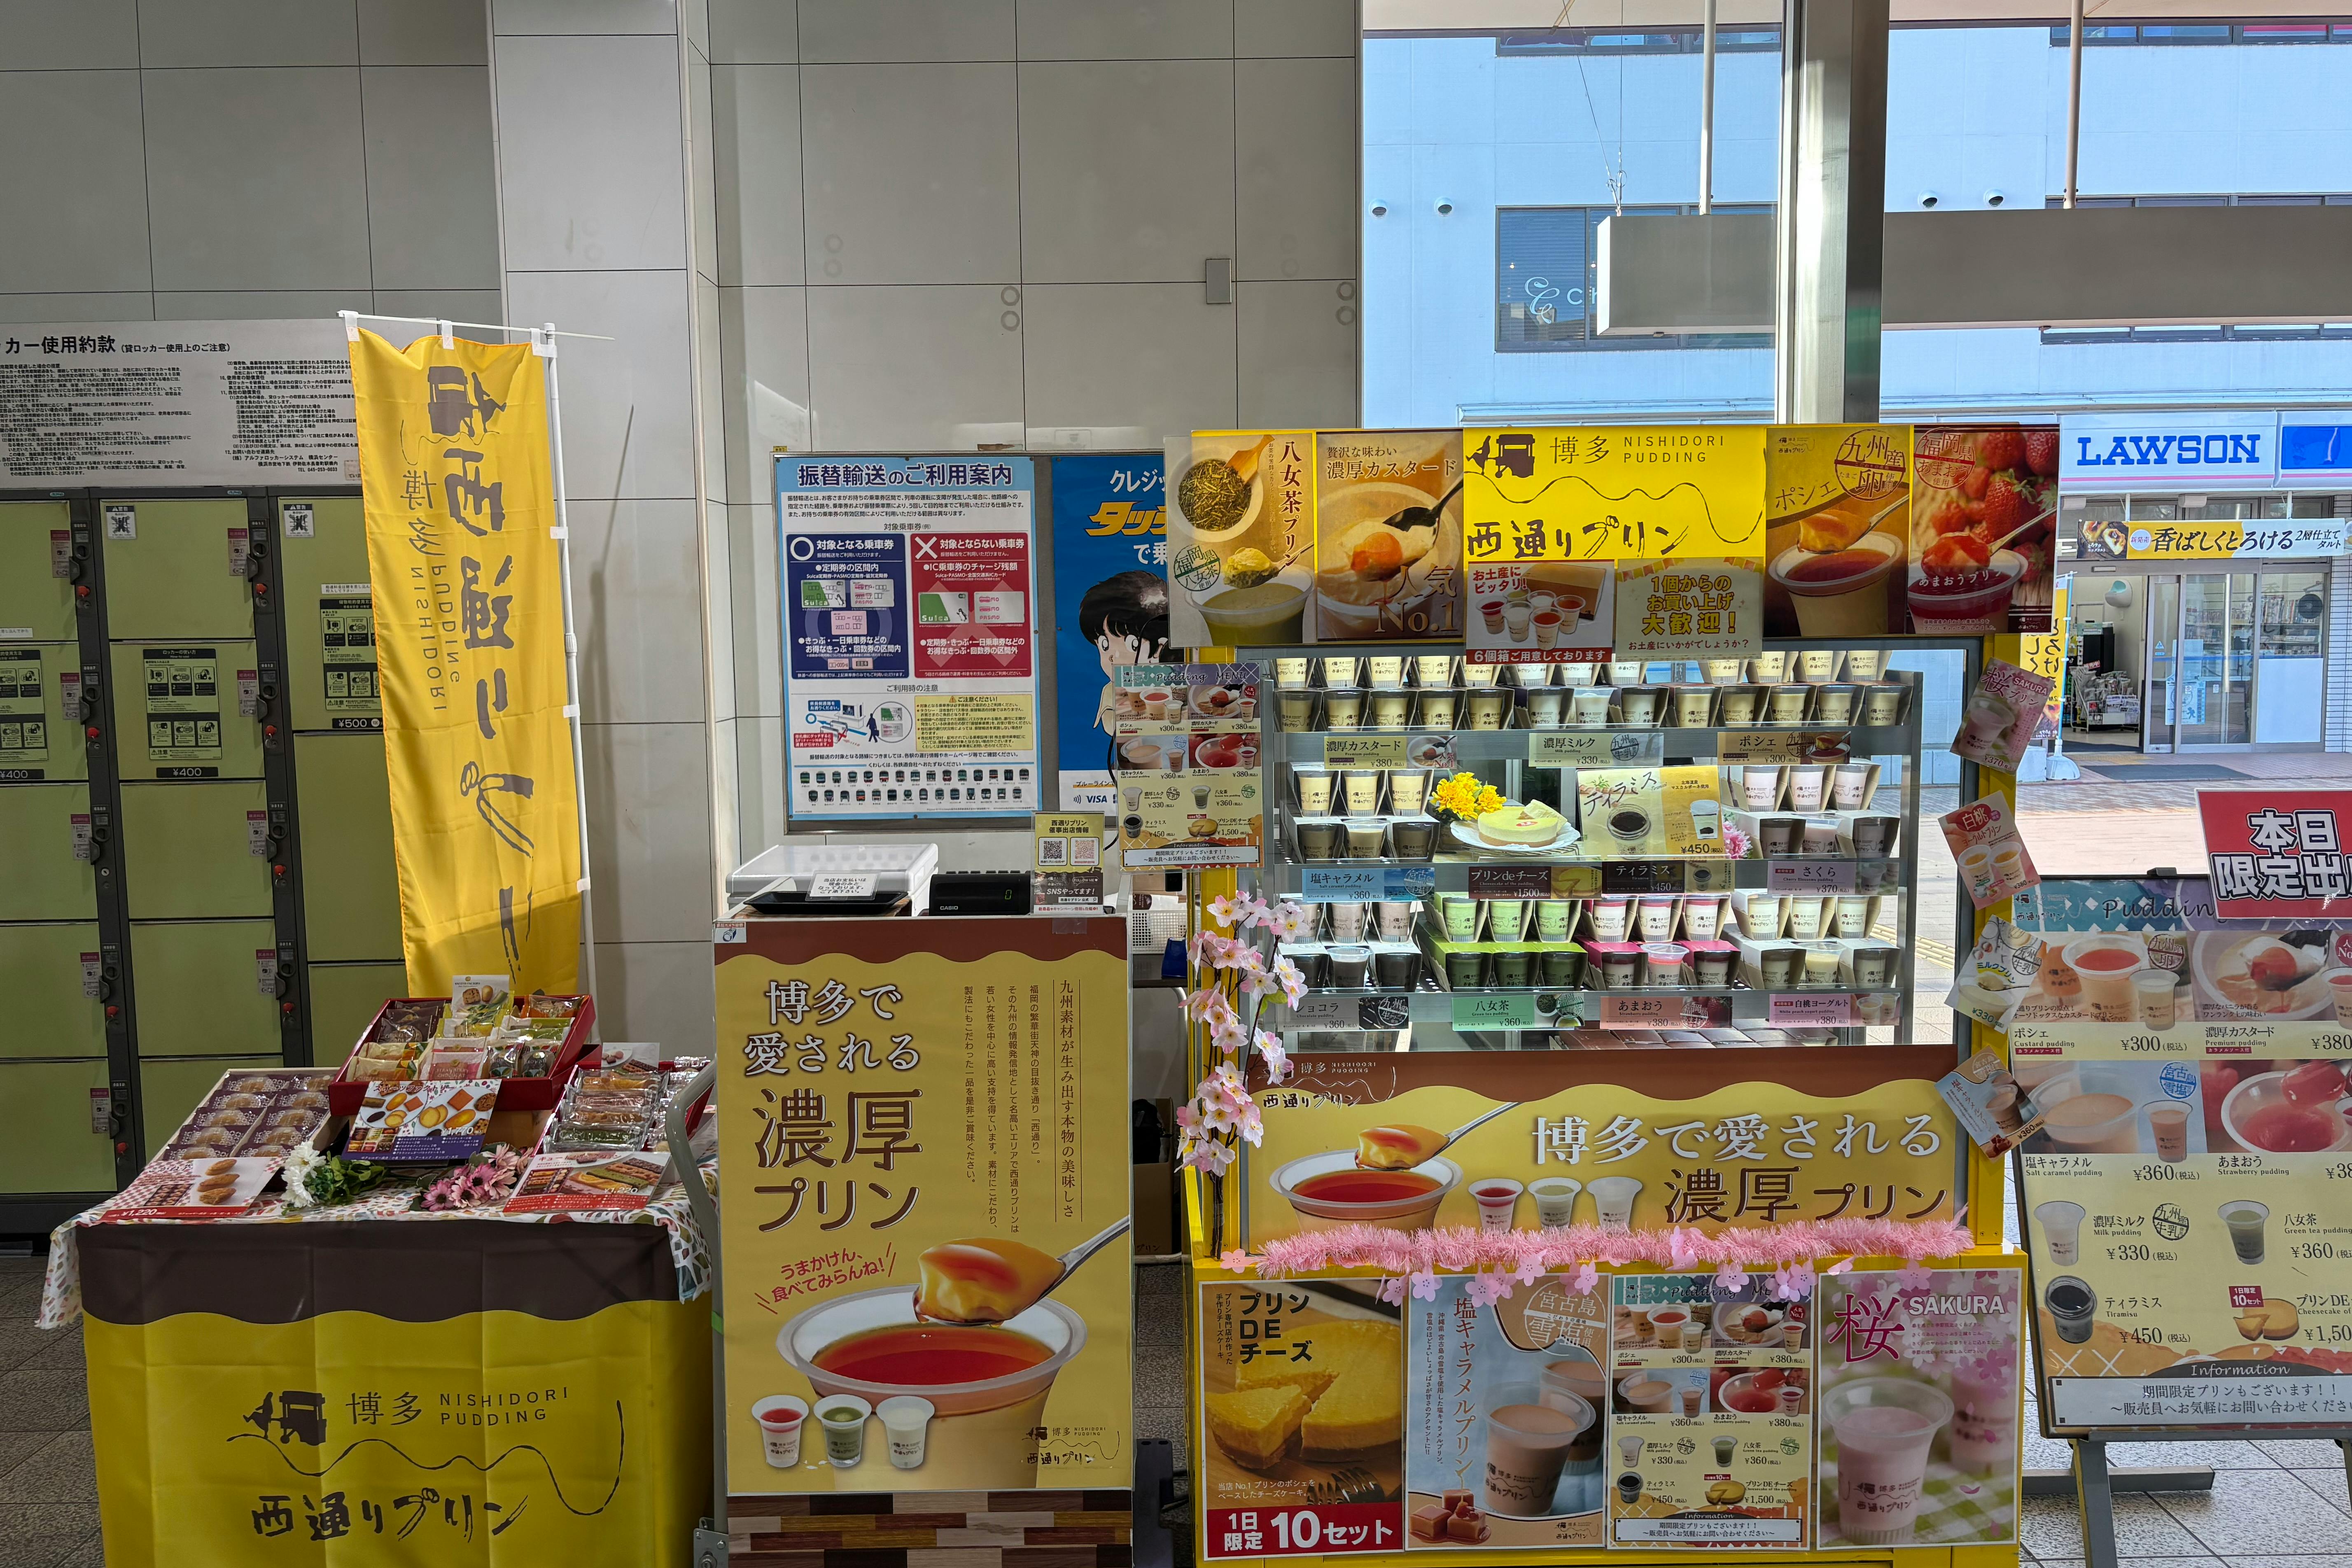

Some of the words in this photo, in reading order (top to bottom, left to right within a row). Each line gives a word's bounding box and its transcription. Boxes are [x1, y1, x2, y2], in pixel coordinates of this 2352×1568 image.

[5, 336, 117, 354] カー使用約款
[1327, 446, 1398, 459] 贅沢な味わい
[1549, 435, 1610, 465] 博多
[1624, 435, 1724, 447] NISHIDORI
[1843, 435, 1904, 468] 九州産
[1921, 432, 1973, 460] 福岡県
[2077, 434, 2261, 466] LAWSON
[1624, 451, 1706, 463] PUDDING
[798, 463, 1012, 487] 振替輸送のご利用案内
[1327, 459, 1456, 480] 濃厚カスタード
[1917, 459, 1970, 479] あまおう
[1857, 469, 1884, 498] 卵
[1279, 441, 1304, 567] 八女茶プリン
[1775, 481, 1838, 511] ポシェ
[940, 539, 1024, 549] 対象とならない乗車券
[1467, 515, 1689, 559] 西通りプリン
[2151, 527, 2294, 553] 香ばしくとろける
[2296, 529, 2341, 542] 2層仕立て
[2317, 539, 2342, 550] タルト
[816, 540, 894, 550] 対象となる乗車券
[1387, 565, 1458, 600] 人気
[1473, 566, 1521, 581] お土産に
[1474, 577, 1528, 594] ピッタリ！
[1651, 575, 1732, 593] 1個からの
[1647, 592, 1735, 612] お買い上げ
[1374, 600, 1458, 633] No.1
[1641, 613, 1737, 635] 大歓迎！
[805, 644, 902, 653] お得なきっぷ・回数券の区間内
[927, 646, 1018, 655] お得なきっぷ・回数券の区間外
[1628, 638, 1749, 650] お土産にいかがでしょうか？
[1474, 649, 1606, 663] 6個箱ご用意しております
[1155, 673, 1208, 684] Pudding
[1215, 671, 1248, 680] MENU
[886, 684, 939, 693] ご利用時の注意
[338, 719, 367, 728] ¥500
[1326, 740, 1402, 752] 濃厚カスタード
[1544, 737, 1596, 749] 濃厚ミルク
[1739, 735, 1777, 747] ポシェ
[1371, 758, 1392, 768] ¥380
[1576, 754, 1598, 764] ¥330
[1764, 754, 1785, 763] ¥300
[173, 768, 202, 776] ¥400
[1086, 795, 1108, 803] VISA
[1962, 807, 1989, 830] 白桃
[2246, 807, 2337, 853] 本日
[1680, 843, 1709, 854] ¥450
[1310, 872, 1374, 884] 塩キャラメル
[1470, 870, 1548, 882] プリンdeチーズ
[1615, 865, 1671, 875] ティラミス
[1803, 865, 1836, 877] さくら
[2209, 852, 2352, 900] 限定出
[1349, 890, 1371, 900] ¥360
[1513, 888, 1540, 898] ¥1,500
[1816, 884, 1838, 894] ¥370
[2102, 898, 2217, 919] Puddin
[765, 979, 903, 1026] 博多で
[1475, 1000, 1510, 1011] 八女茶
[1619, 1000, 1662, 1012] あまおう
[1795, 997, 1849, 1008] 白桃ヨーグルト
[1323, 1019, 1345, 1029] ¥360
[2205, 1026, 2275, 1038] 濃厚カスタード
[2045, 1040, 2075, 1048] pudding
[2121, 1035, 2161, 1052] ¥300
[742, 1032, 921, 1076] 愛される
[1029, 985, 1041, 1165] 福岡の繁華街天神の目抜き通り「西通り」。
[1301, 1062, 1327, 1074] 博多
[1059, 978, 1077, 1218] 九州素材が生み出す本物の美味しさ
[1263, 1090, 1362, 1109] 西通りプリン
[986, 985, 999, 1230] 若い女性を中心に高い支持を得ています。素材にこだわり、
[753, 1087, 924, 1171] 濃厚
[1532, 1113, 1940, 1165] 博多で愛される
[2025, 1156, 2093, 1168] 塩キャラメル
[754, 1176, 920, 1232] プリン
[1664, 1166, 1948, 1225] 濃厚プリン
[2093, 1214, 2146, 1228] 濃厚ミルク
[2106, 1244, 2150, 1262] ¥330
[780, 1248, 864, 1280] うまかけん、
[772, 1256, 885, 1302] 食べてみらんね！
[1239, 1292, 1310, 1315] プリン
[1539, 1291, 1597, 1316] 宮古島
[1908, 1295, 2005, 1316] SAKURA
[1216, 1293, 1224, 1359] 手作りチーズケーキ
[1225, 1293, 1233, 1365] プリン専門店が作った
[1239, 1319, 1282, 1339] DE
[1829, 1294, 1906, 1363] 桜
[1239, 1340, 1313, 1365] チーズ
[2191, 1364, 2290, 1377] Information
[1453, 1297, 1477, 1476] 塩キャラメルプリン
[2142, 1384, 2338, 1399] 期間限定プリンもございます！！
[346, 1391, 422, 1426] 博多
[440, 1387, 569, 1406] NISHIDORI
[441, 1408, 547, 1426] PUDDING
[252, 1487, 529, 1543] 西通りプリン
[1270, 1510, 1393, 1549] 10セット
